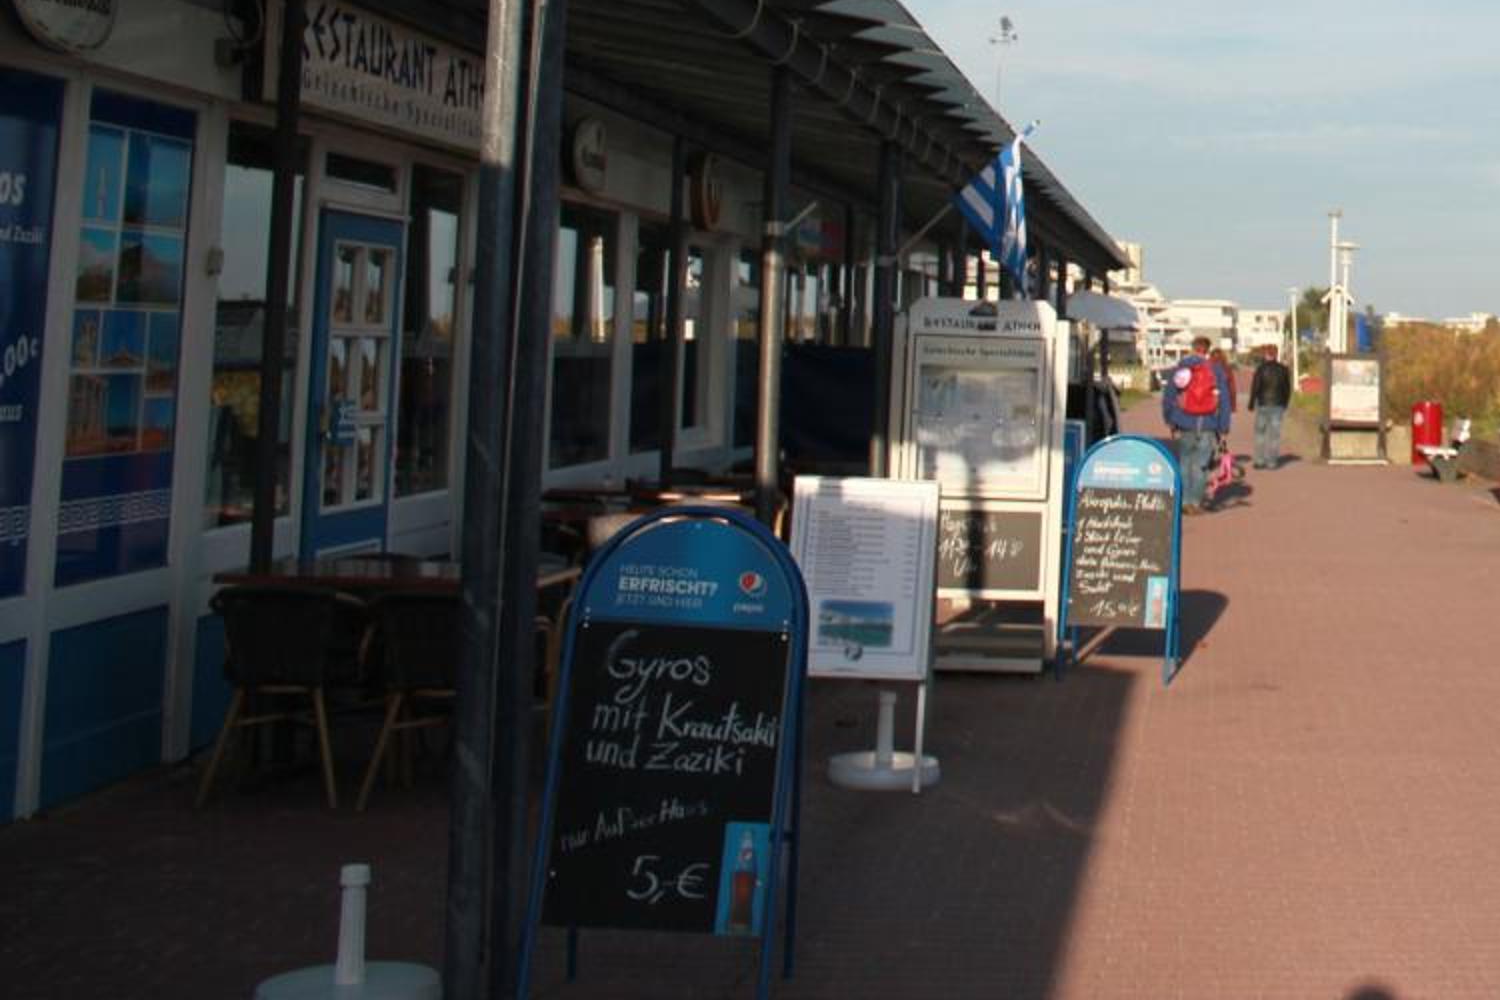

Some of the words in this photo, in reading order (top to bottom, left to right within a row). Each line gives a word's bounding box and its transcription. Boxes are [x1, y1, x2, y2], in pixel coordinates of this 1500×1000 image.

[444, 57, 485, 111] ATH
[618, 577, 719, 598] ERFRISCHT?
[658, 565, 698, 579] SCHON
[608, 630, 710, 703] Gyros
[593, 698, 648, 732] mit
[586, 735, 640, 769] und
[644, 741, 746, 775] Zaziki
